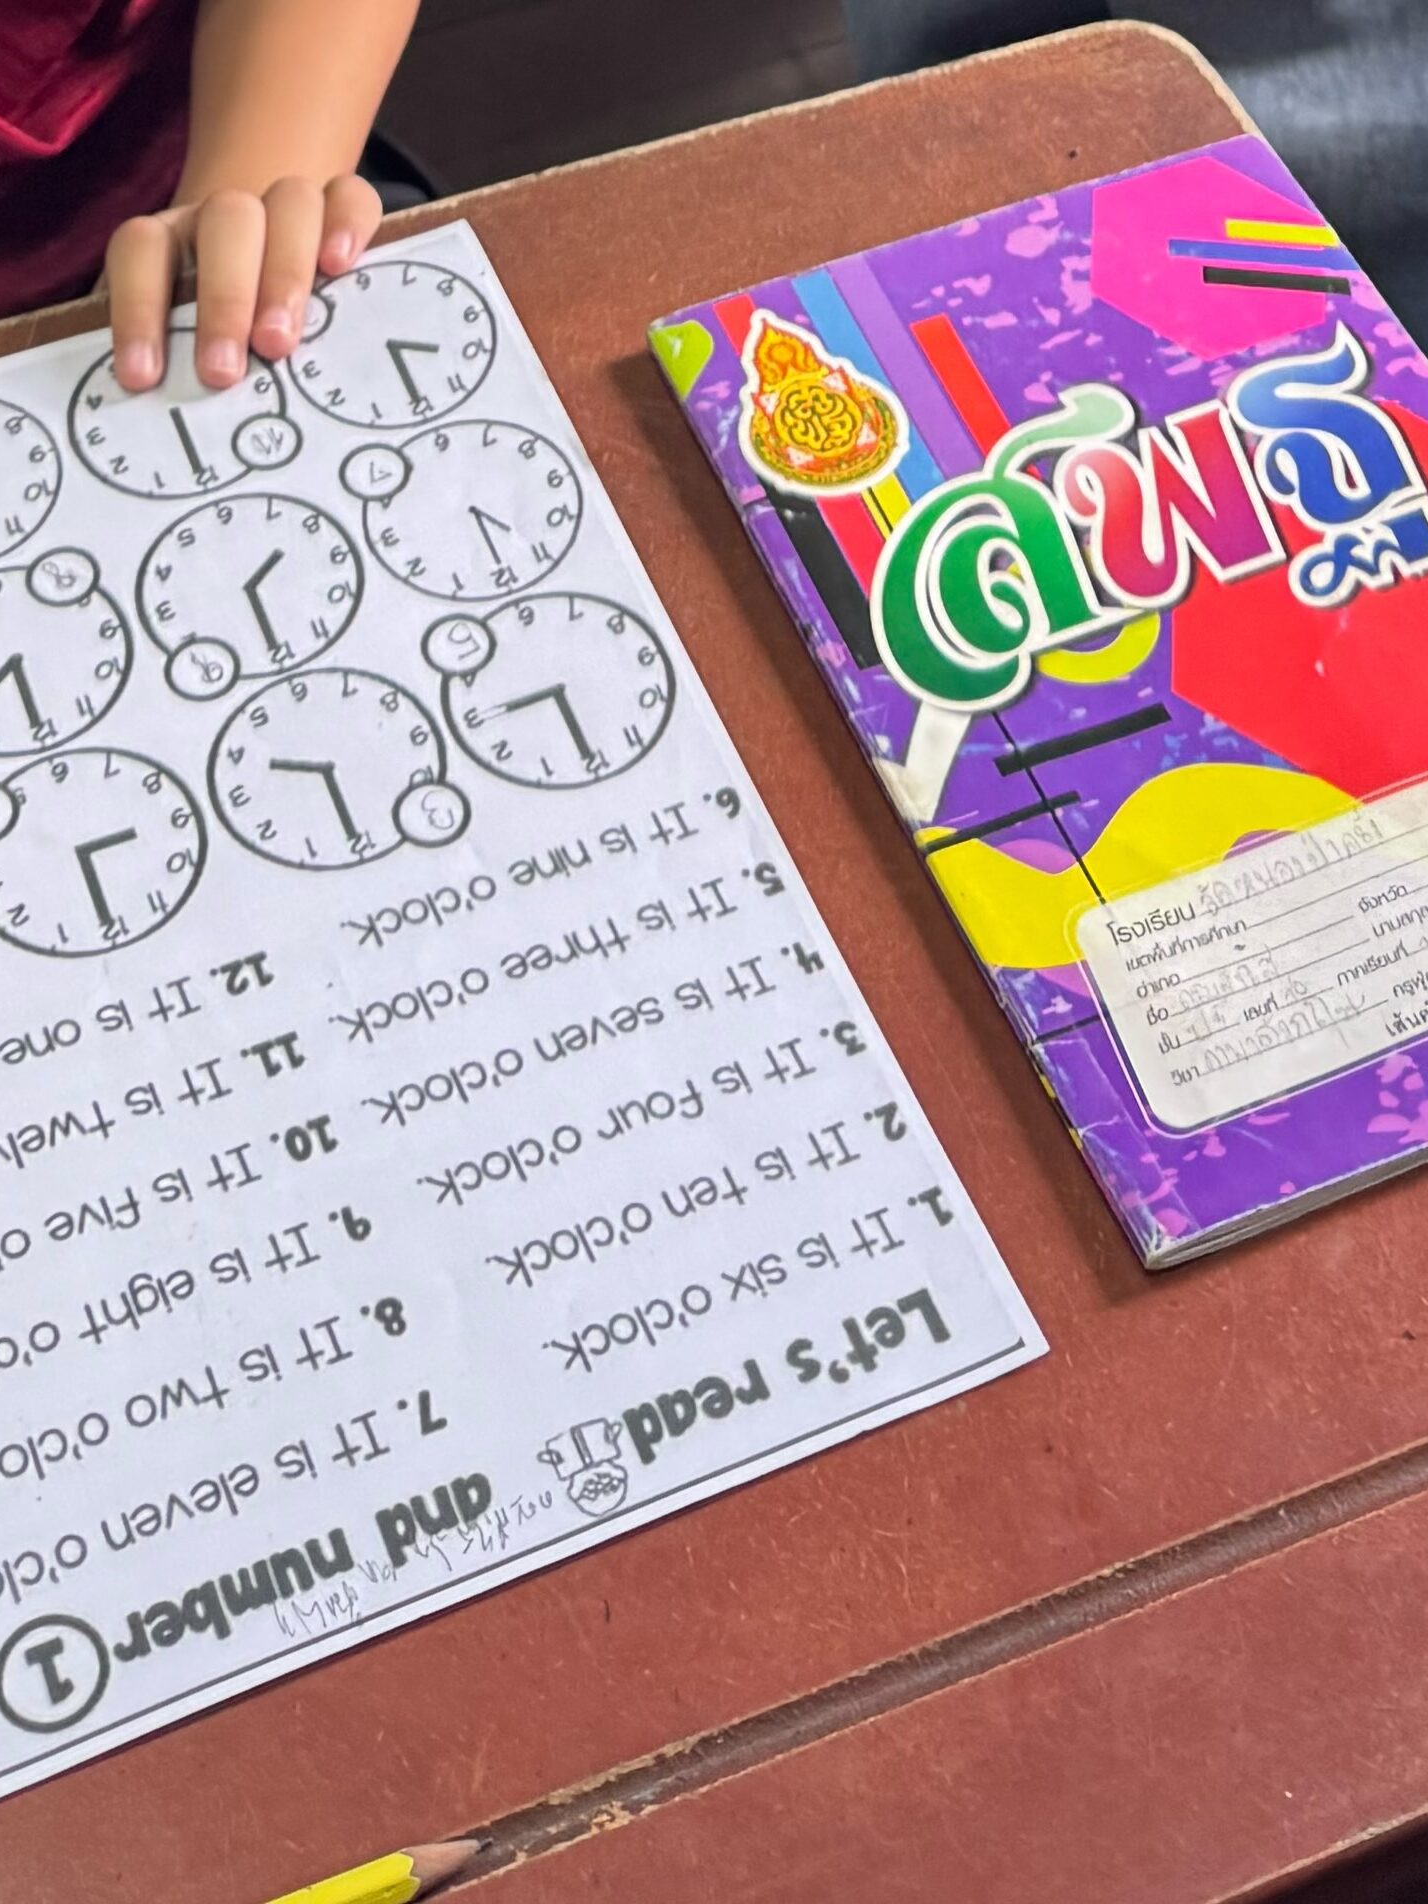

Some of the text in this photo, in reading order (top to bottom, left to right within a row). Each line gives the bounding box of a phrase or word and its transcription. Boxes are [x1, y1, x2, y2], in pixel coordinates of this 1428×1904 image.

[3, 415, 23, 436] 8
[481, 422, 497, 448] 7
[27, 444, 47, 464] 9
[433, 432, 450, 453] 6
[516, 438, 536, 460] 8
[22, 479, 55, 502] 10
[546, 468, 564, 489] 9
[215, 505, 233, 525] 6
[265, 495, 282, 521] 7
[545, 503, 577, 528] 10
[4, 514, 25, 536] 11
[301, 511, 321, 535] 8
[176, 527, 196, 548] 5
[379, 526, 400, 547] 3
[328, 544, 348, 565] 9
[530, 541, 555, 564] 11
[154, 564, 172, 583] 4
[405, 556, 426, 577] 2
[489, 564, 518, 588] 12
[326, 580, 358, 604] 10
[451, 571, 464, 592] 1
[154, 599, 176, 622] 3
[517, 605, 535, 627] 6
[566, 594, 584, 622] 7
[309, 616, 330, 639] 11
[605, 611, 625, 635] 8
[265, 640, 295, 665] 12
[636, 645, 656, 667] 9
[637, 683, 669, 709] 10
[462, 706, 485, 729] 3
[622, 723, 644, 748] 11
[490, 738, 513, 762] 2
[579, 750, 610, 774] 12
[50, 761, 69, 784] 6
[103, 751, 121, 779] 7
[539, 756, 554, 777] 1
[141, 769, 162, 795] 8
[169, 806, 190, 829] 9
[164, 847, 198, 874] 10
[339, 786, 741, 948] 6. It is nine o'clock.
[6, 902, 30, 927] 2
[146, 889, 169, 914] 11
[56, 922, 69, 944] 1
[98, 915, 130, 941] 12
[1106, 903, 1198, 947] โรงเรียน
[327, 861, 786, 1043] 5. It is three o'clock.
[208, 950, 274, 996] 12.
[147, 975, 201, 1023] It
[94, 998, 134, 1032] is
[360, 941, 825, 1127] 4. It is seven o'clock.
[239, 1030, 306, 1078] 11.
[176, 1056, 232, 1106] It
[123, 1081, 165, 1116] is
[416, 1020, 867, 1206] 3. It is four o'clock.
[268, 1113, 338, 1162] 10.
[206, 1141, 262, 1192] It
[151, 1167, 193, 1203] is
[484, 1100, 907, 1288] 2. It is ten o'clock.
[43, 1185, 141, 1241] five
[327, 1205, 372, 1242] 9.
[264, 1221, 321, 1273] It
[208, 1247, 251, 1284] is
[541, 1184, 954, 1373] 1. It is six o'clock.
[77, 1269, 195, 1345] eight
[358, 1296, 407, 1337] 8.
[295, 1315, 353, 1371] It
[786, 1288, 950, 1383] Let's
[238, 1342, 282, 1382] is
[124, 1364, 230, 1428] two
[395, 1389, 448, 1436] 7.
[622, 1359, 770, 1464] read
[331, 1409, 390, 1468] It
[273, 1438, 318, 1479] is
[100, 1462, 259, 1552] eleven
[375, 1472, 494, 1568] and
[113, 1528, 354, 1662] number
[24, 1637, 74, 1704] 1
